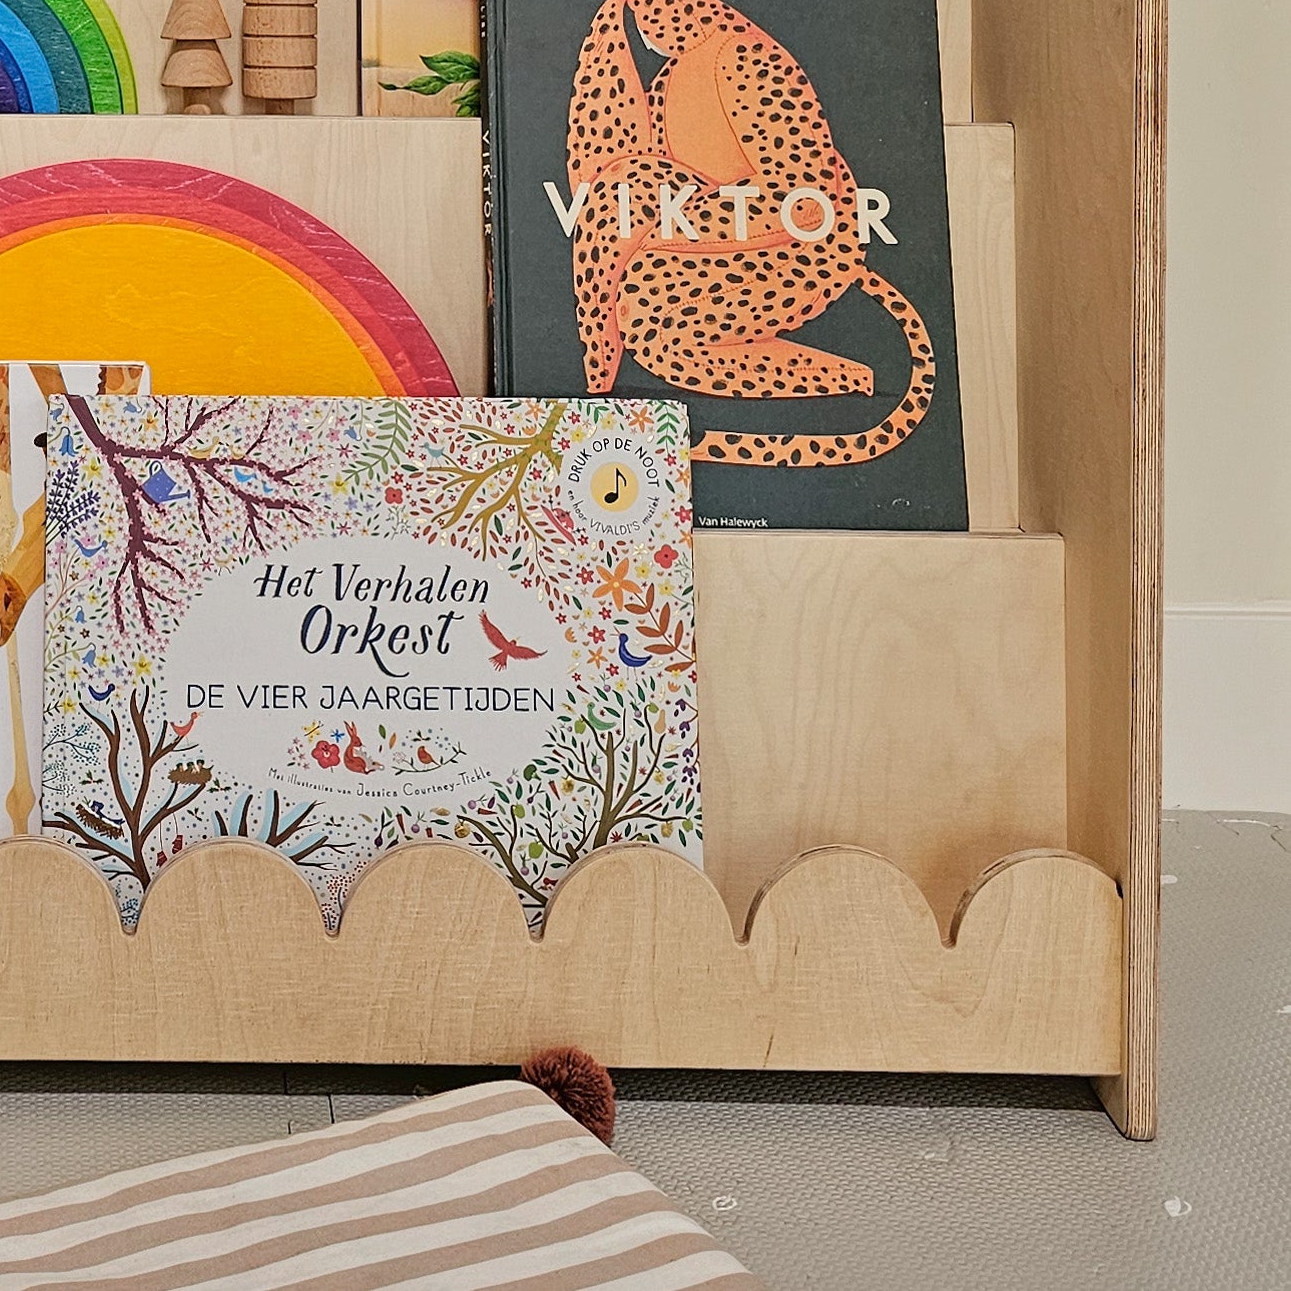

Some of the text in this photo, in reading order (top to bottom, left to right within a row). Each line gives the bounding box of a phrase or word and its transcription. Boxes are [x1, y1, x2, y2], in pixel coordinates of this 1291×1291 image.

[482, 130, 492, 236] VIKTOR
[543, 181, 898, 244] VIKTOR
[568, 437, 660, 488] DRUK OP DE NOOT
[590, 518, 641, 536] VIVALDI'S
[698, 516, 768, 528] Van Halewyck
[253, 563, 489, 604] Het Verhalen
[300, 604, 465, 678] Orkest
[186, 684, 554, 712] DE VIER JAARGETIJDEN
[356, 782, 398, 797] Jessica
[402, 766, 492, 796] Courtney-Tickle
